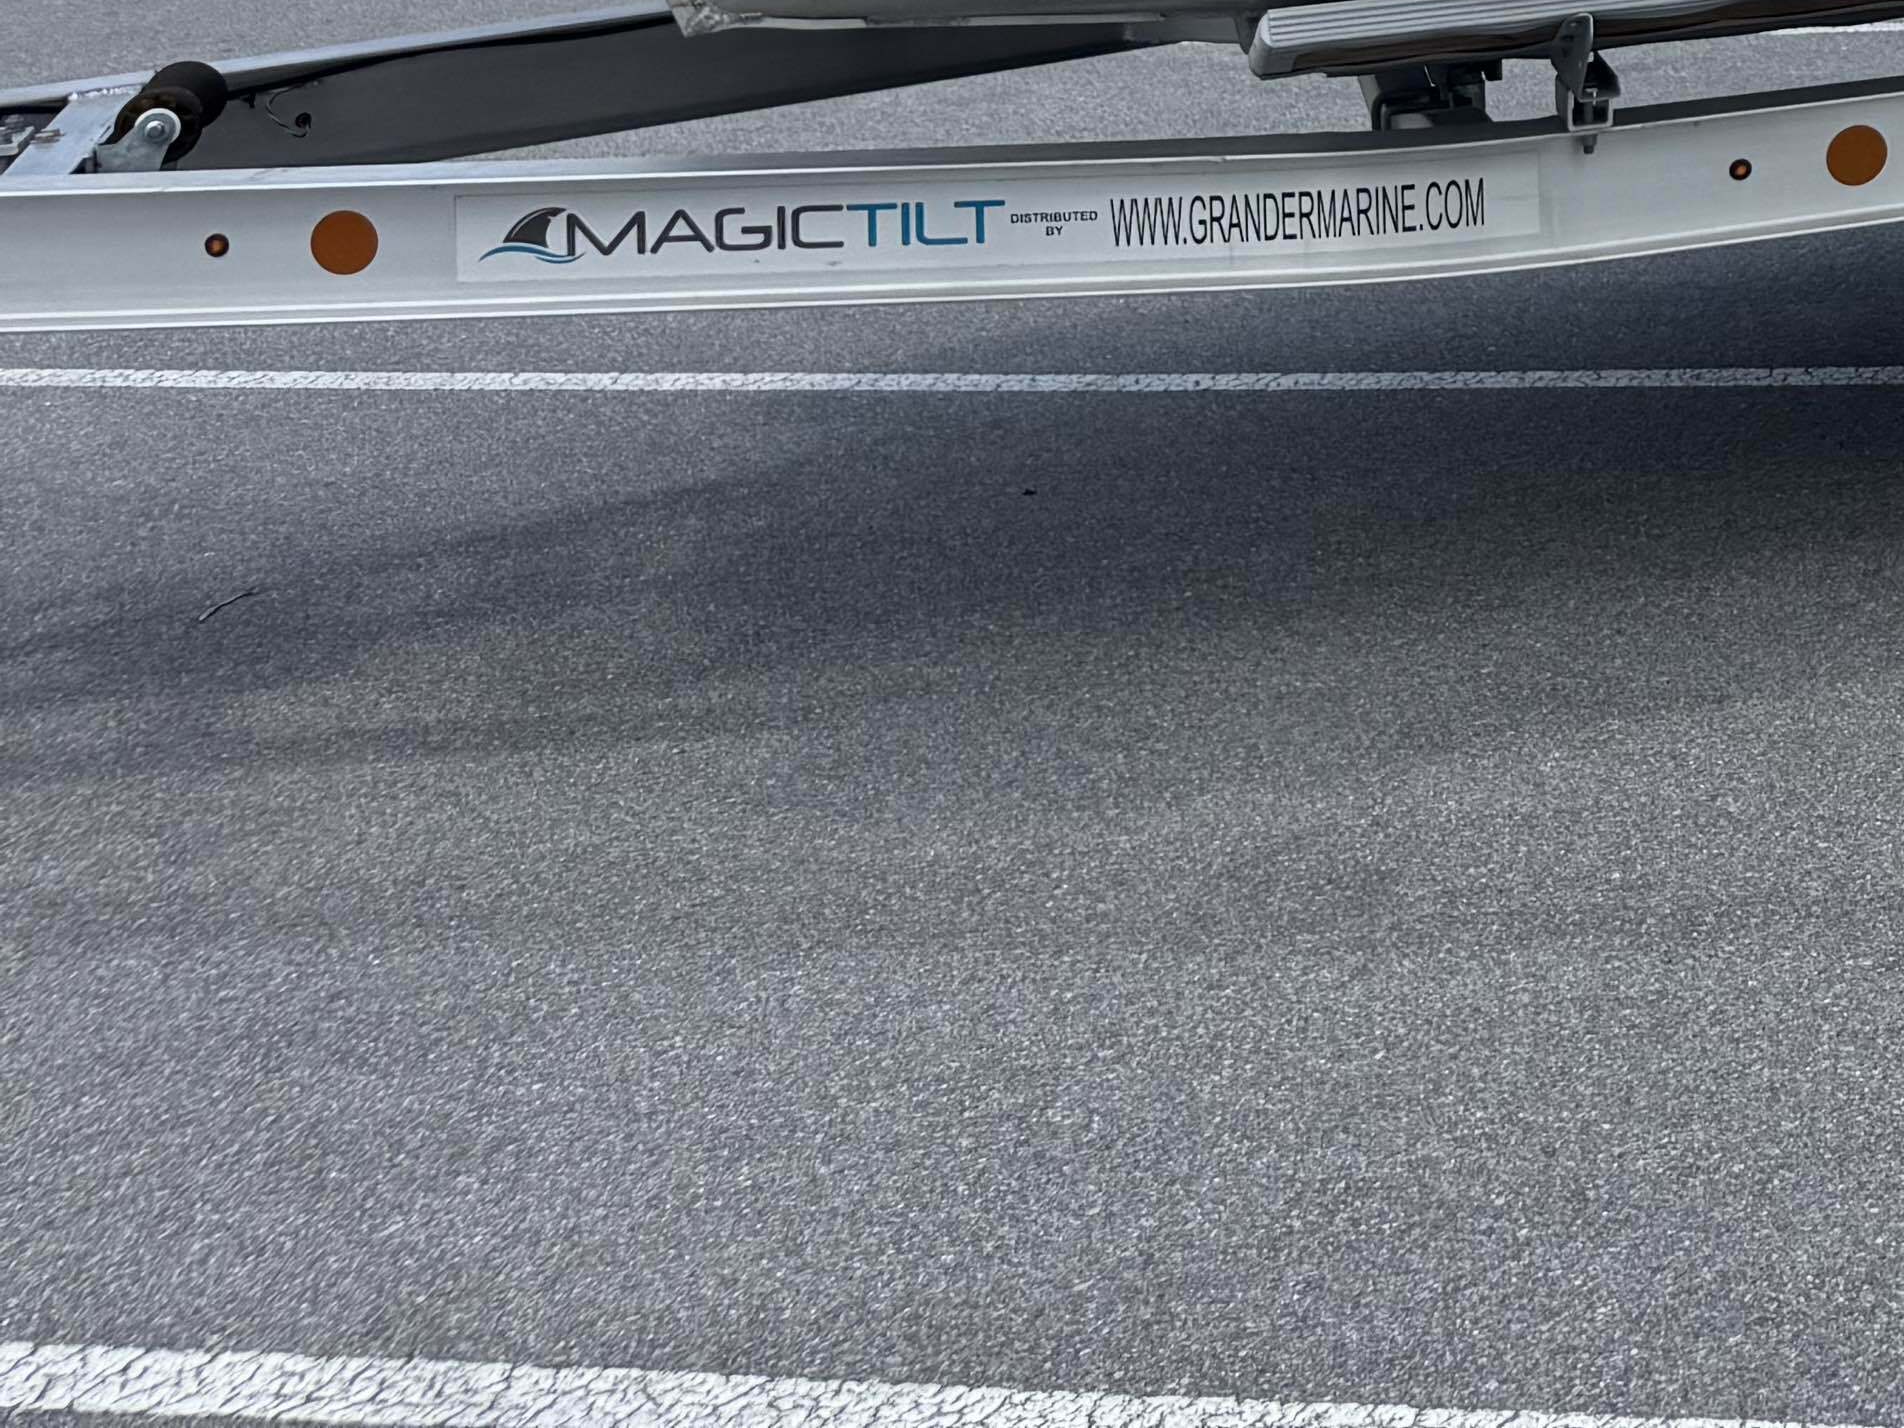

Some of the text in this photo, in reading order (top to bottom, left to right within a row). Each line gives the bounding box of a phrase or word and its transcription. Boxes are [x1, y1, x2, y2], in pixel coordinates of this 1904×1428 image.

[565, 199, 1006, 257] MAGICTILT
[1010, 210, 1098, 224] DISTRIBUTED
[1110, 177, 1486, 247] WWW.GRANDERMARINE.COM
[1045, 225, 1063, 236] BY
